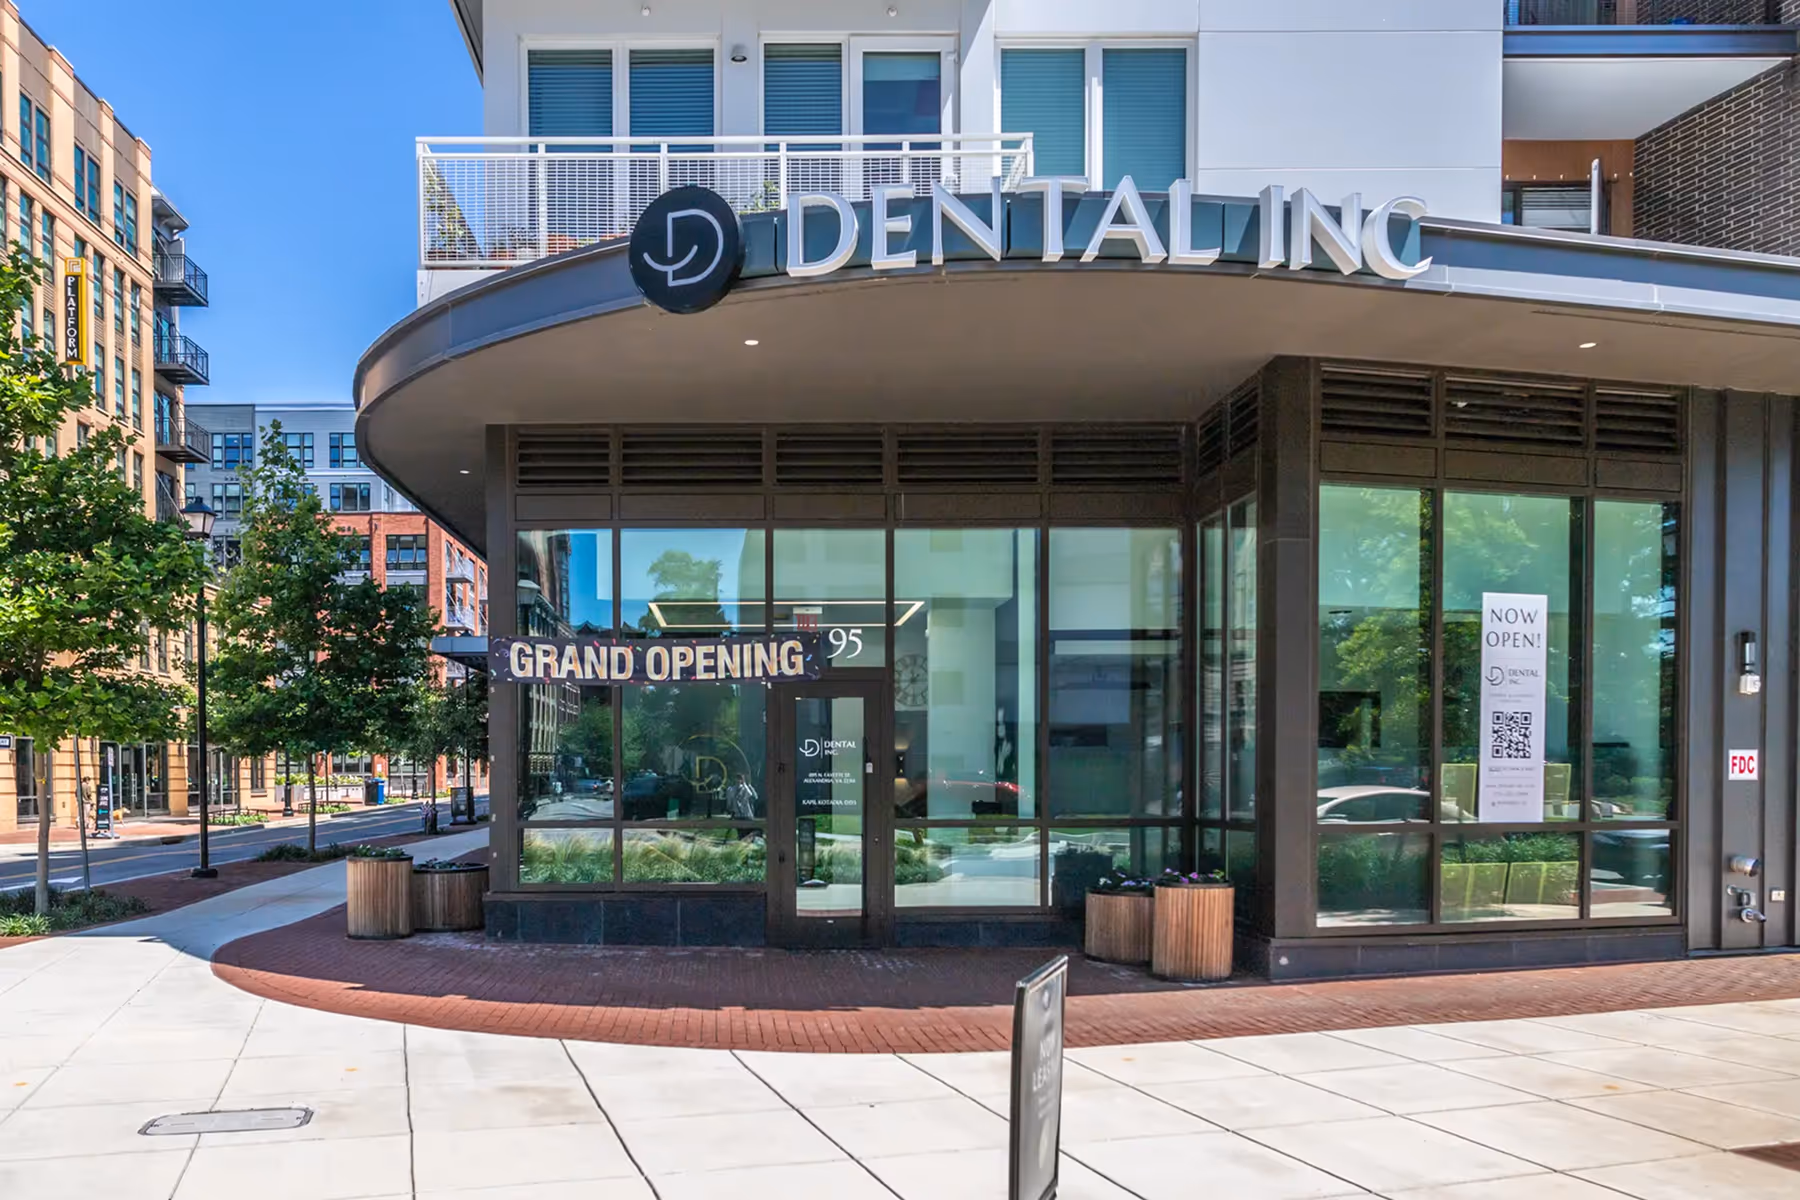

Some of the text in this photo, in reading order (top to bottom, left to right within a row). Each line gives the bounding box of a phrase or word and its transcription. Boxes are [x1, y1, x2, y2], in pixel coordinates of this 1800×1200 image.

[786, 174, 1221, 278] DENTAL
[1257, 183, 1434, 281] INC
[67, 276, 77, 358] PLATFORM
[1490, 607, 1538, 625] NOW
[826, 627, 863, 659] 95
[1485, 630, 1541, 649] OPEN!
[509, 639, 805, 681] GRAND OPENING
[1508, 668, 1540, 678] DENTAL
[824, 740, 857, 749] DENTAL
[1731, 755, 1755, 774] FDC
